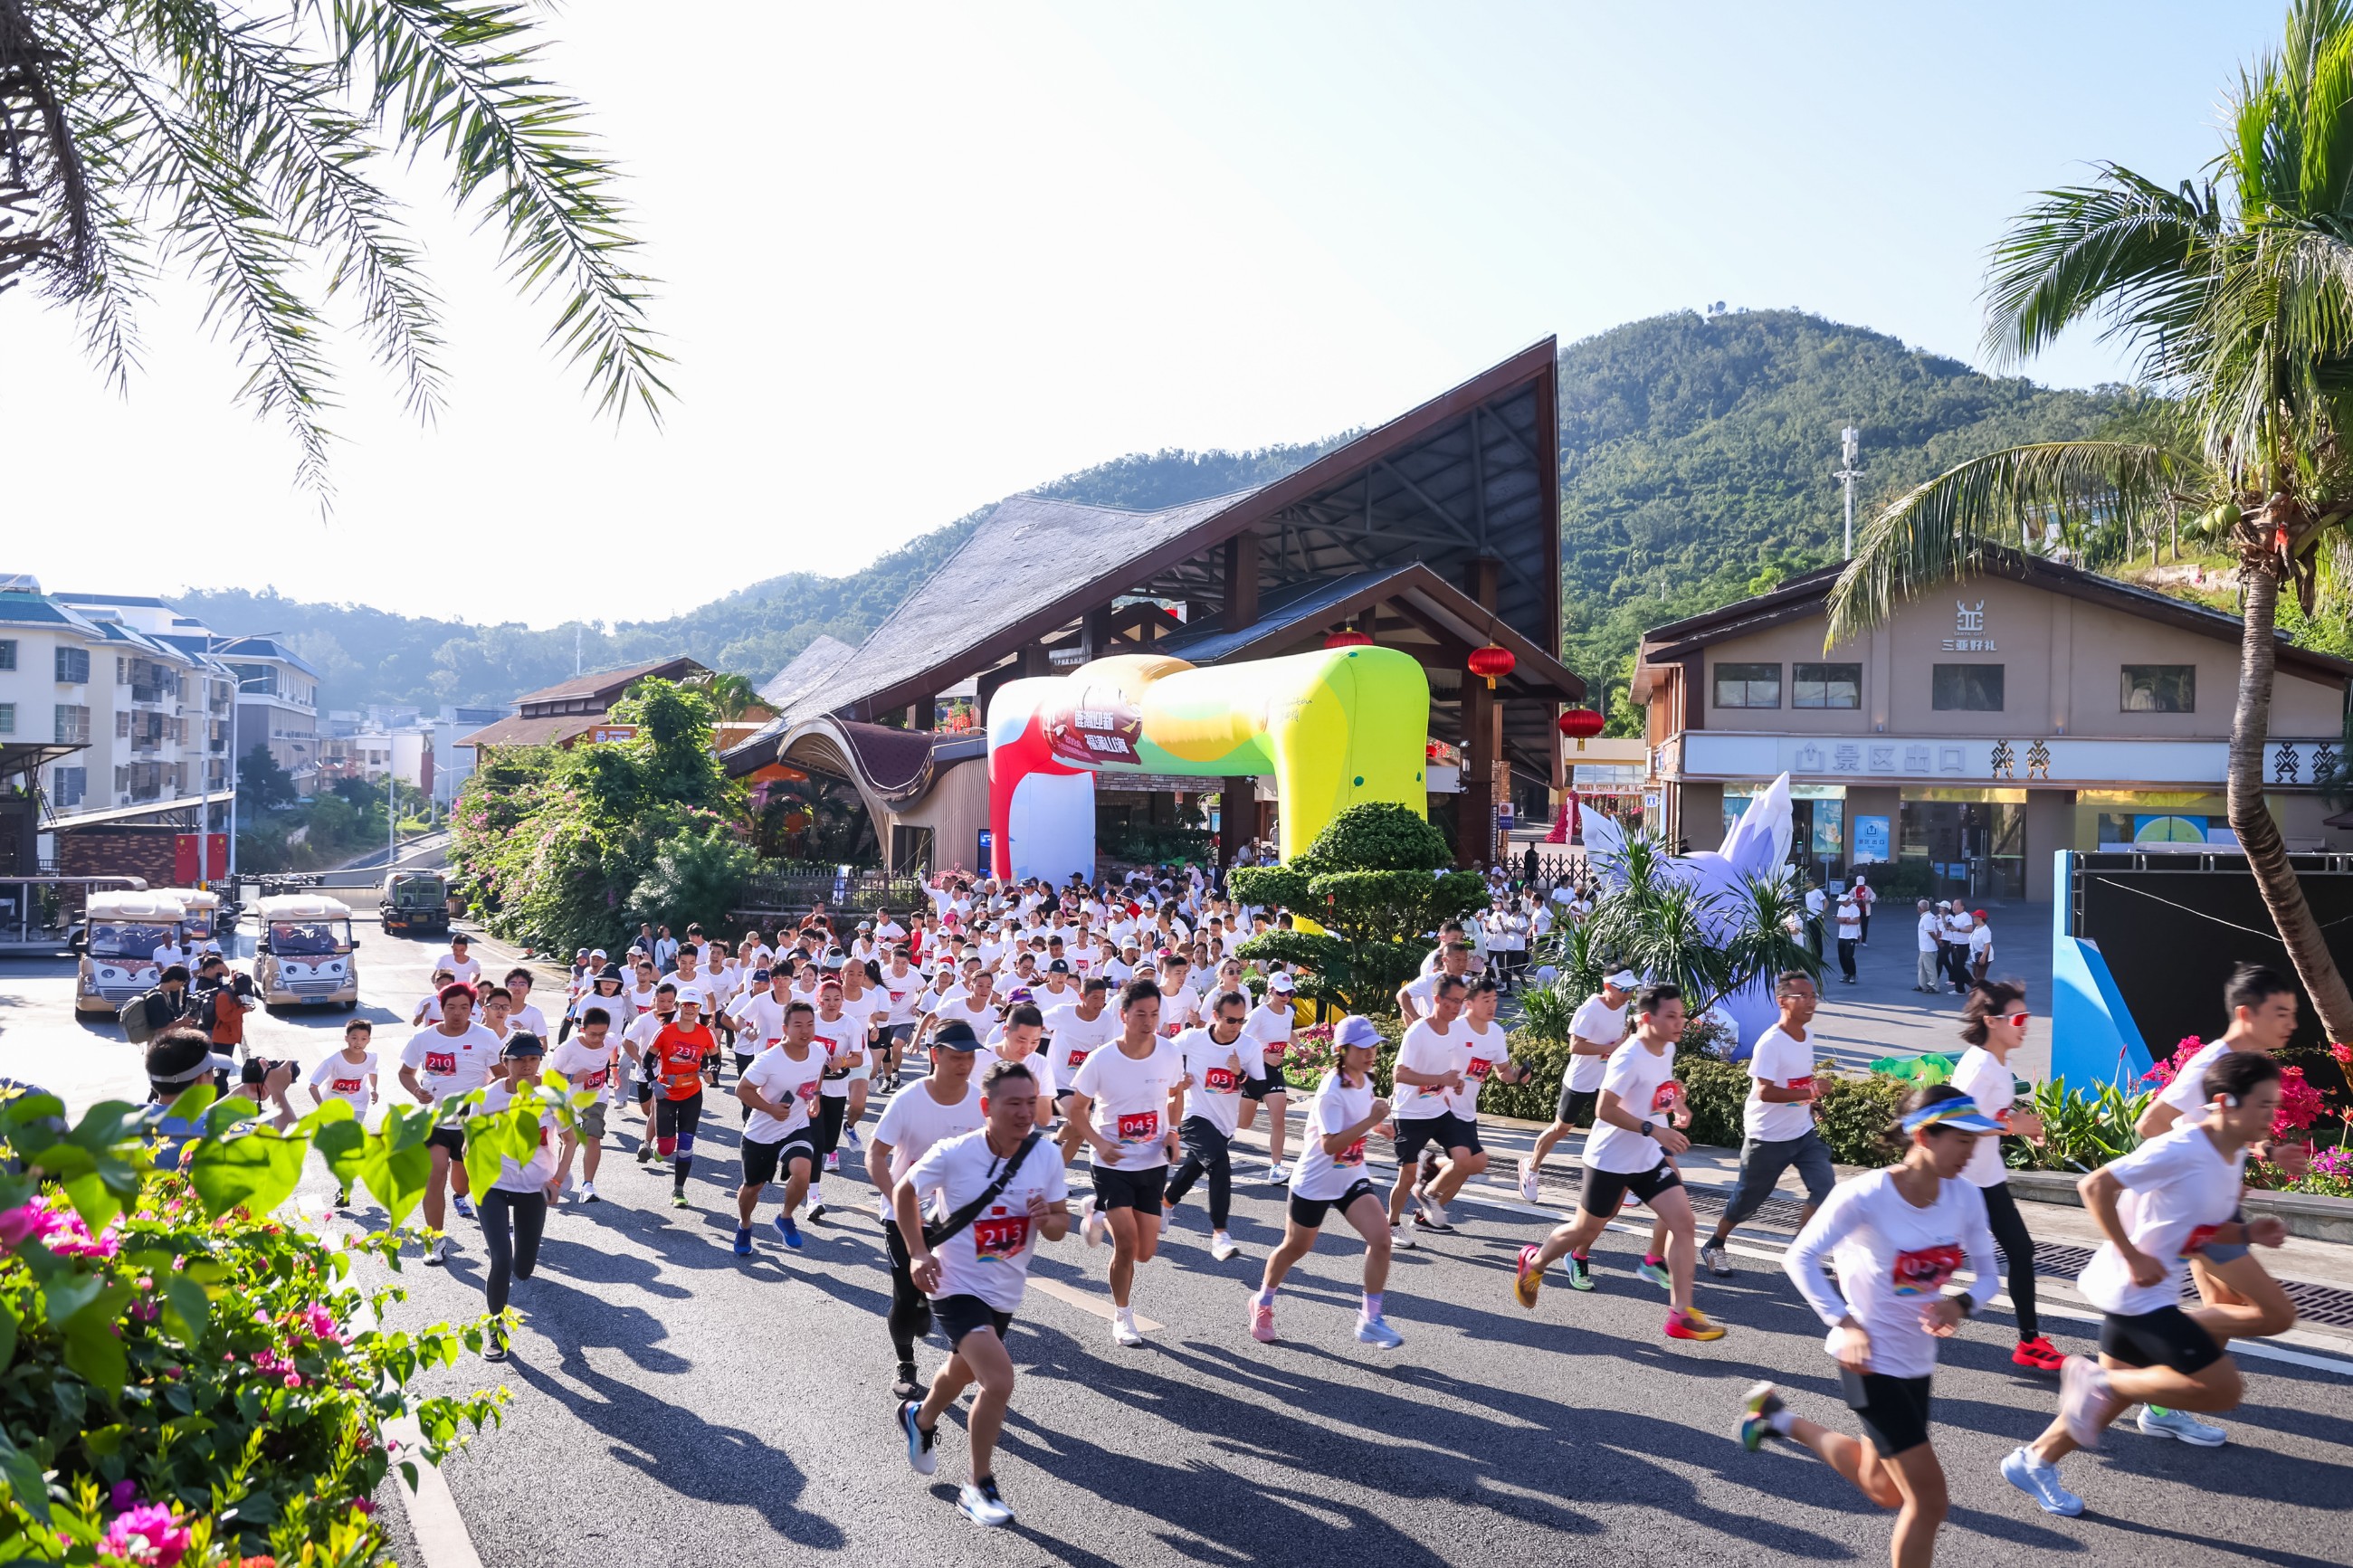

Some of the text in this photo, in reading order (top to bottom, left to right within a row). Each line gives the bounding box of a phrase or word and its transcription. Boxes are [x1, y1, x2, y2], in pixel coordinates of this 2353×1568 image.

[1084, 734, 1129, 754] 福满山海
[1833, 744, 1966, 772] 景区出口
[677, 1046, 696, 1059] 231
[428, 1058, 452, 1068] 210
[338, 1082, 357, 1090] 041
[1211, 1073, 1235, 1086] 031
[1123, 1117, 1154, 1133] 045
[984, 1224, 1024, 1247] 213
